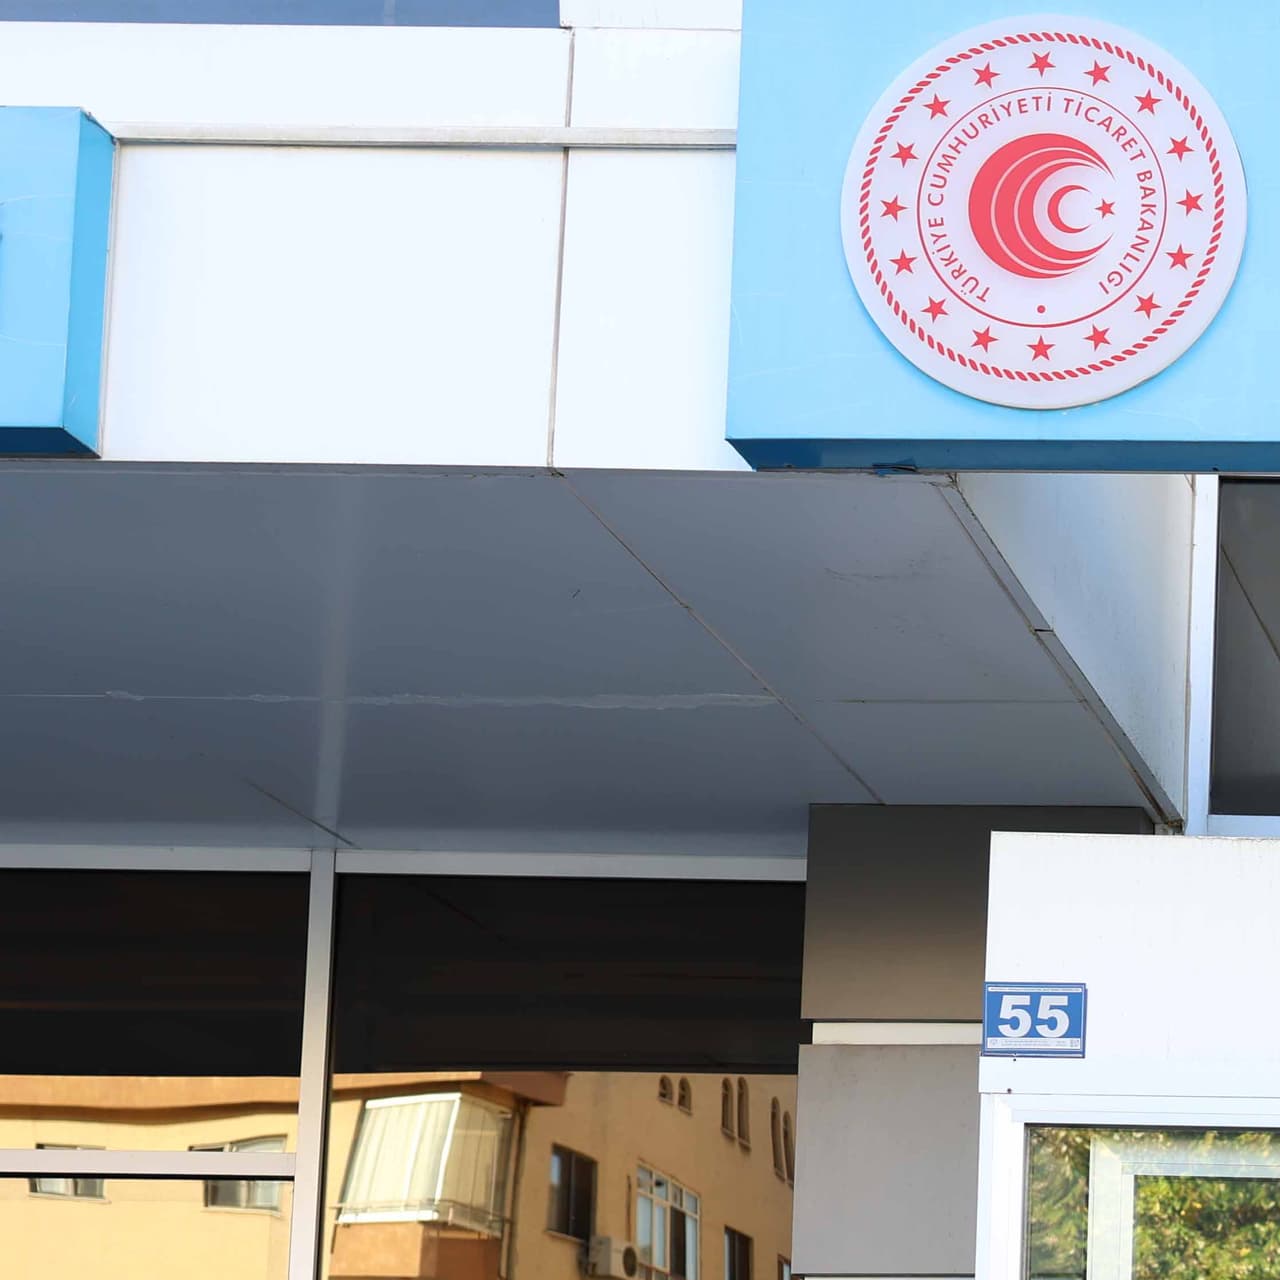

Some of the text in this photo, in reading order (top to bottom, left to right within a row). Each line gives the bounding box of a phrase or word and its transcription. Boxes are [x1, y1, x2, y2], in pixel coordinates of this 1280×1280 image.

[927, 91, 1052, 207] CUMHURİYETİ
[1063, 96, 1146, 162] TİCARET
[927, 216, 991, 303] TÜRKİYE
[997, 994, 1070, 1039] 55
